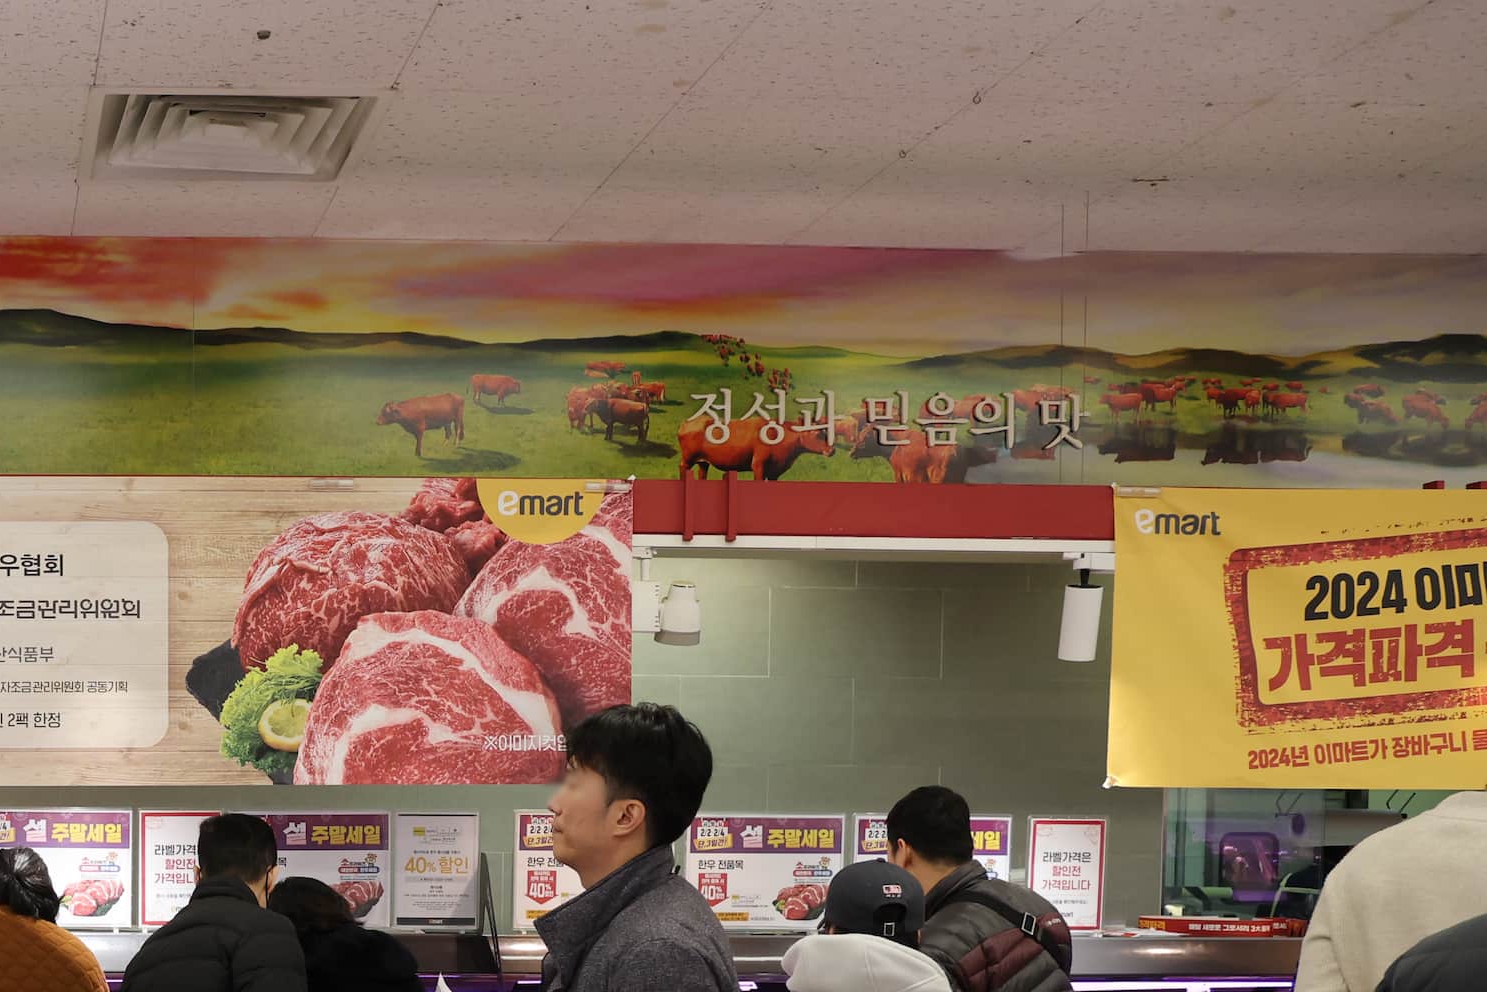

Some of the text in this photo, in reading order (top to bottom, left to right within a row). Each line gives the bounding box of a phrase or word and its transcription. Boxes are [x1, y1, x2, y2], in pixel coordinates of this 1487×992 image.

[685, 388, 1090, 450] 정성과 믿음의 맛
[497, 490, 584, 516] emart
[1134, 508, 1222, 537] emart
[1304, 569, 1408, 622] 2024
[1262, 618, 1475, 692] 가격파격
[7, 712, 29, 729] 2팩
[33, 712, 62, 729] 한정
[1248, 748, 1310, 770] 2024년
[1313, 738, 1389, 765] 이마트가
[1391, 730, 1468, 758] 장바구니
[22, 818, 123, 844] 설 주말세일
[282, 821, 381, 846] 설 주말세일
[740, 825, 835, 849] 설 주말세일
[154, 845, 197, 855] 라벨가격
[1042, 851, 1092, 863] 라벨가격은
[404, 856, 469, 874] 40% 할인
[527, 857, 546, 868] 한우
[697, 859, 745, 870] 한우 전품목
[1052, 865, 1081, 877] 할인전
[1042, 879, 1091, 890] 가격입니다
